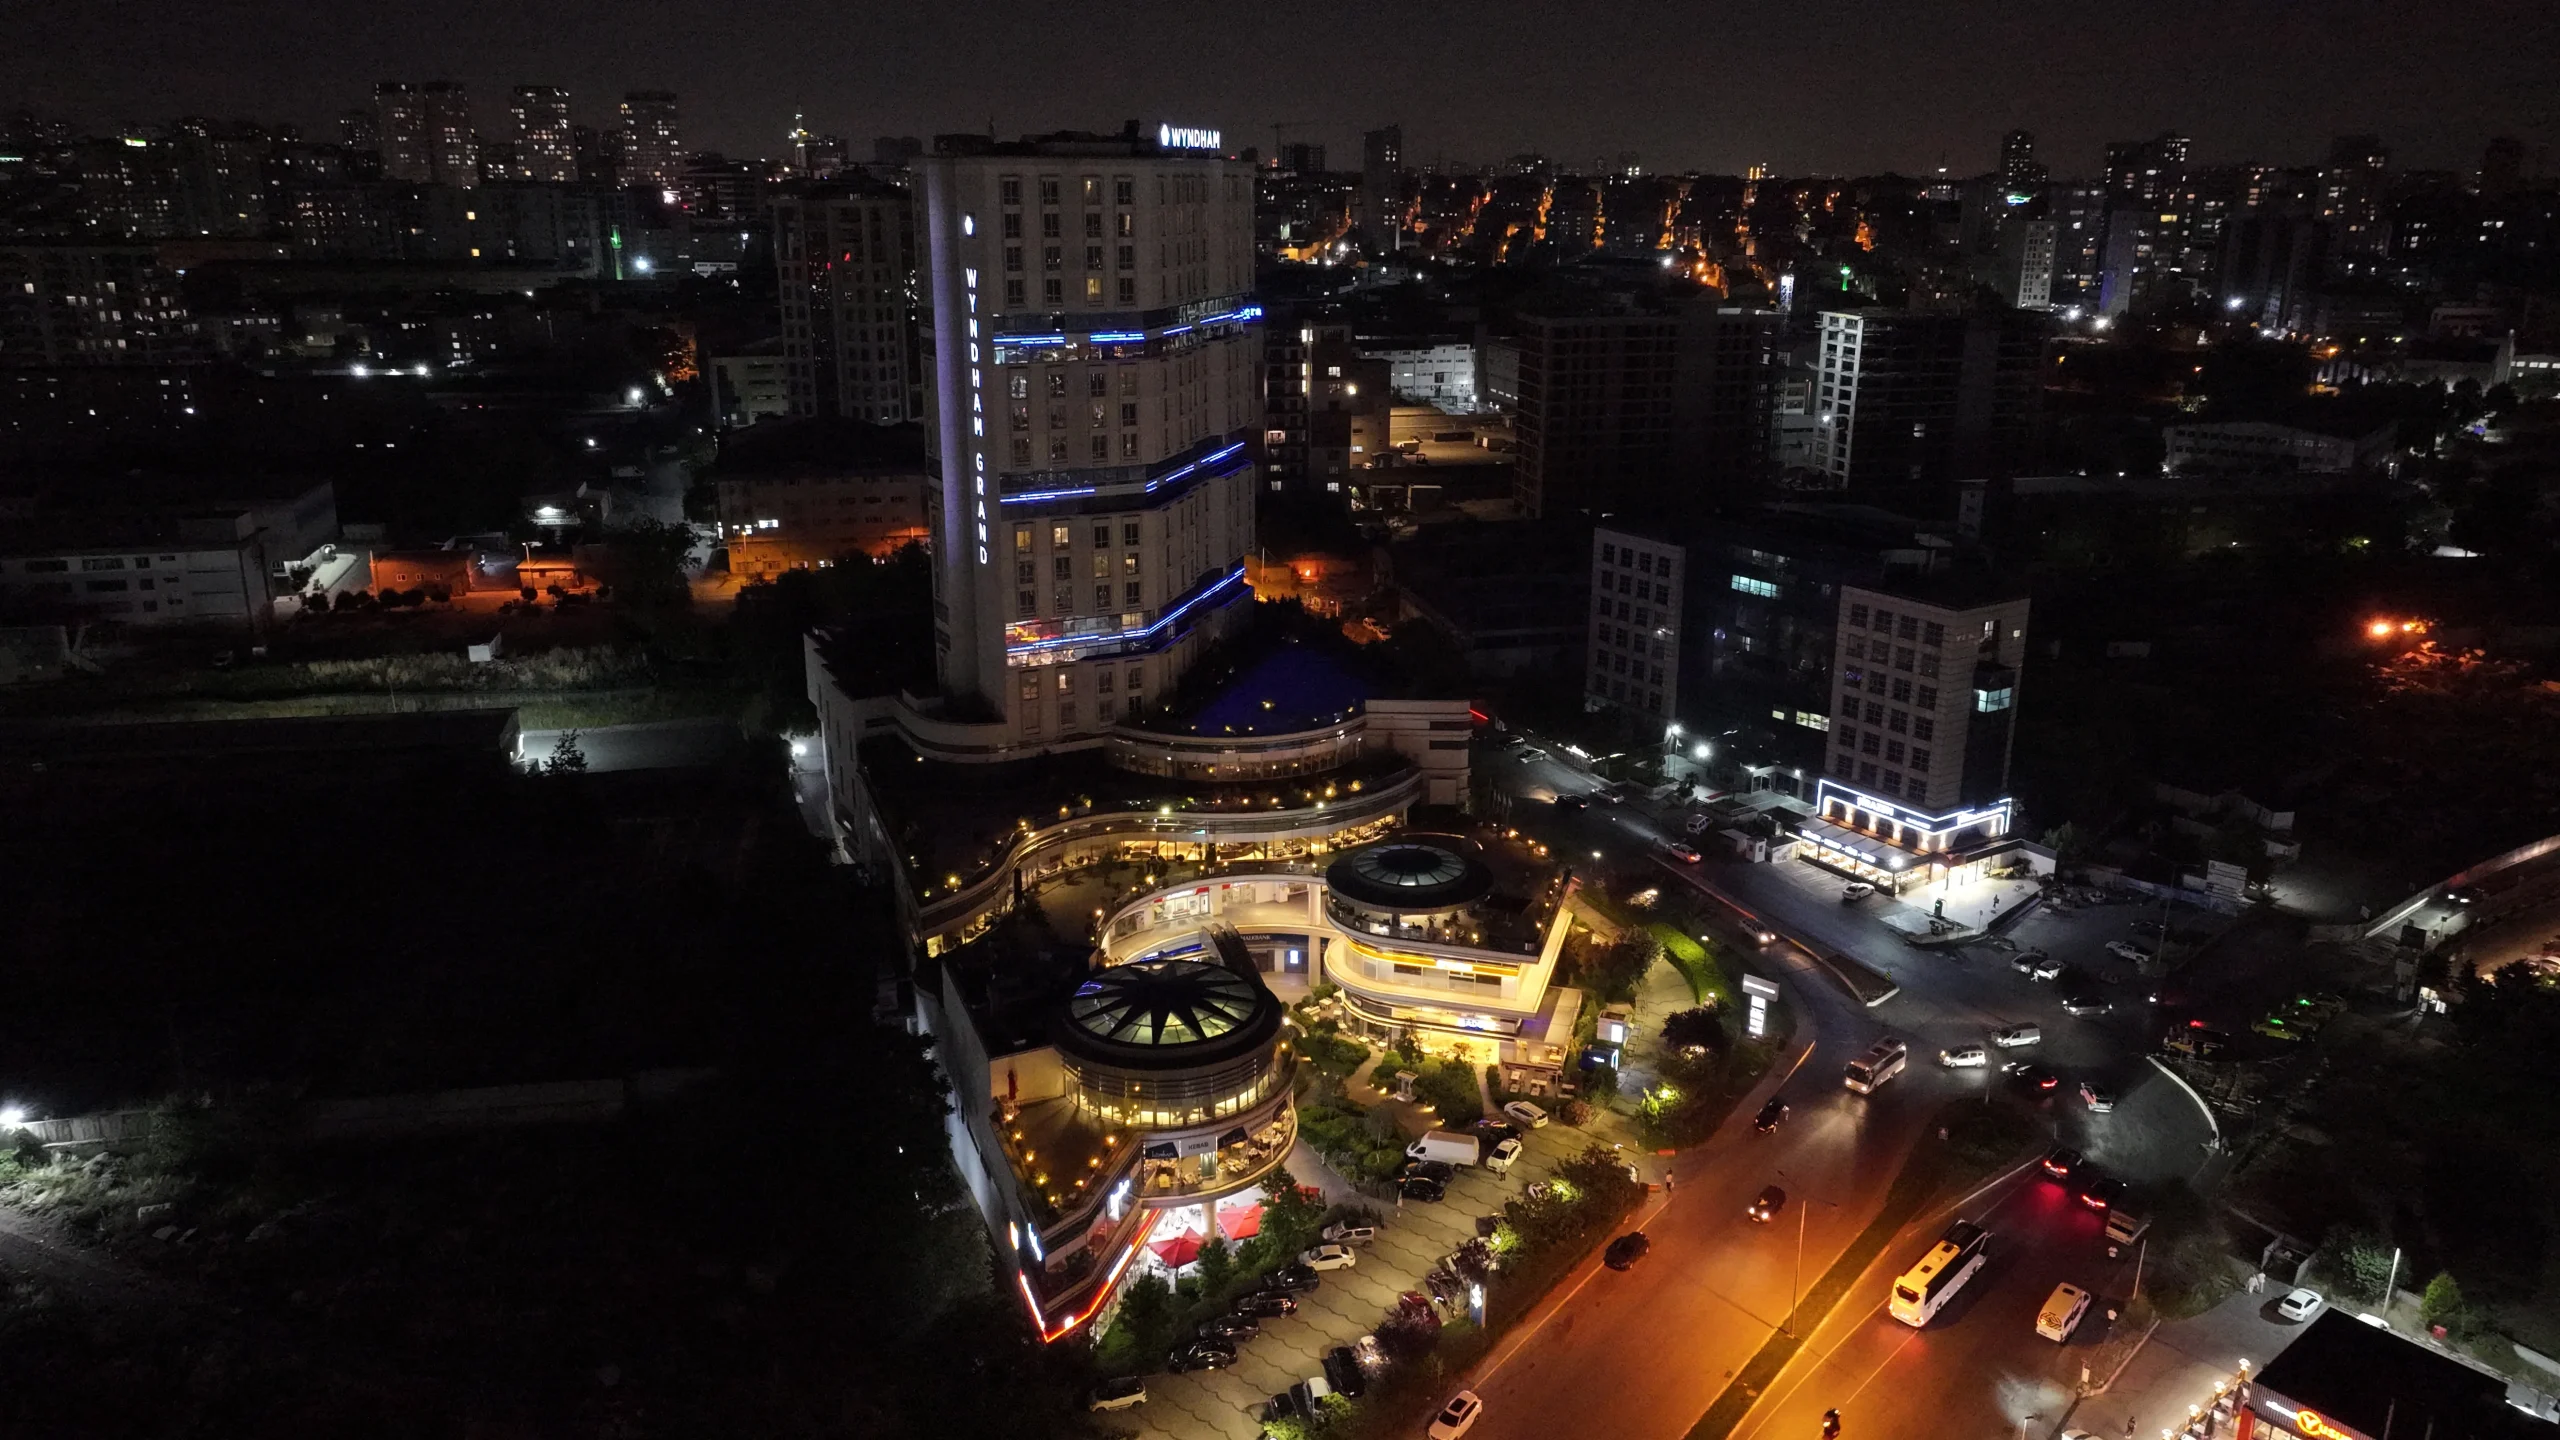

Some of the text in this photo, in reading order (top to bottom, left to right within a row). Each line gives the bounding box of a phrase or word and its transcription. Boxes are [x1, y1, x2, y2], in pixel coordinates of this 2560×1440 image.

[1171, 127, 1221, 149] WYNDHAM
[965, 267, 988, 565] WYNDHAM GRAND
